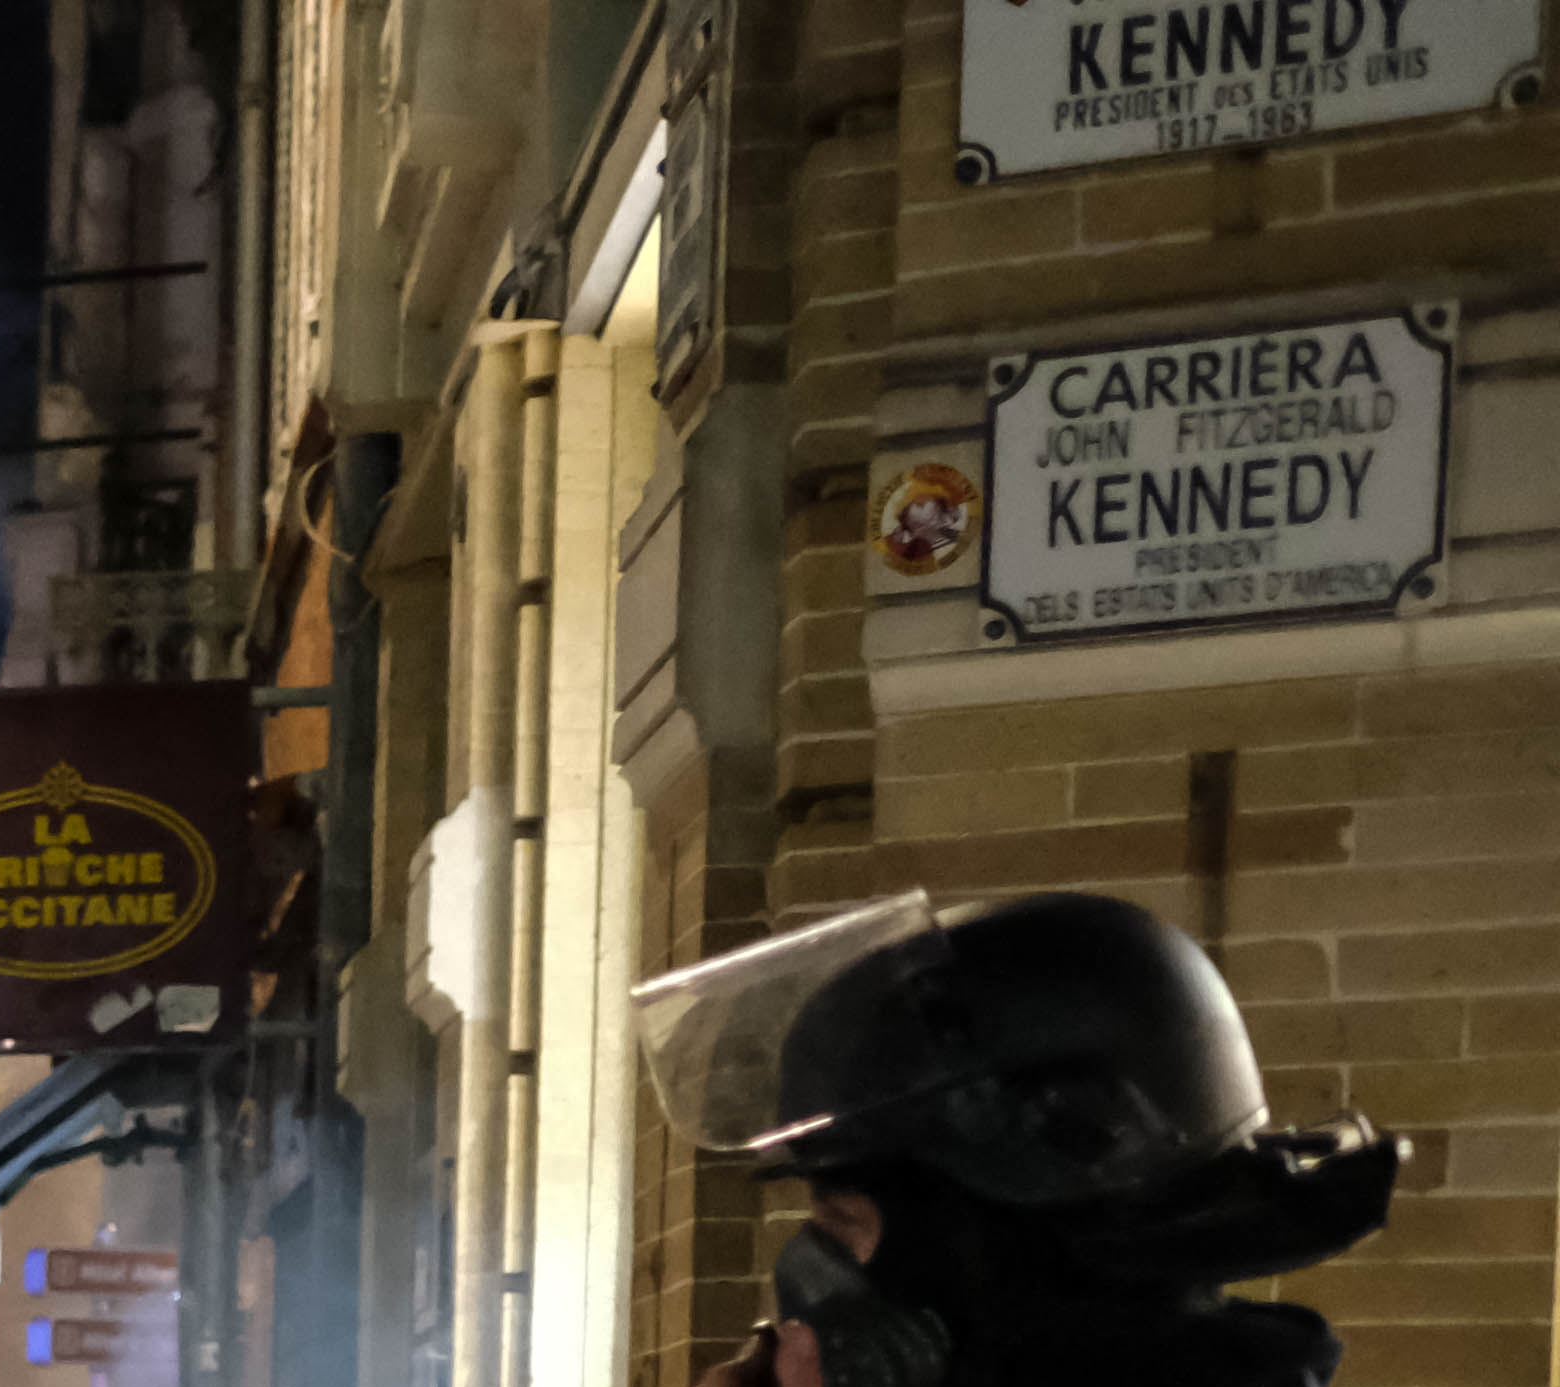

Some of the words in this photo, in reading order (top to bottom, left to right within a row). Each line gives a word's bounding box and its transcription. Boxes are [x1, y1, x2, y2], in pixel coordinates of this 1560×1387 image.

[1054, 82, 1199, 132] PRESIDENT
[1270, 61, 1349, 100] ETATS
[1365, 47, 1430, 87] UNIS
[1068, 0, 1410, 94] KENNEDY
[1036, 421, 1130, 469] JOHN
[1177, 390, 1397, 453] FITZGERALD
[1048, 448, 1375, 548] KENNEDY
[33, 813, 92, 846] LA
